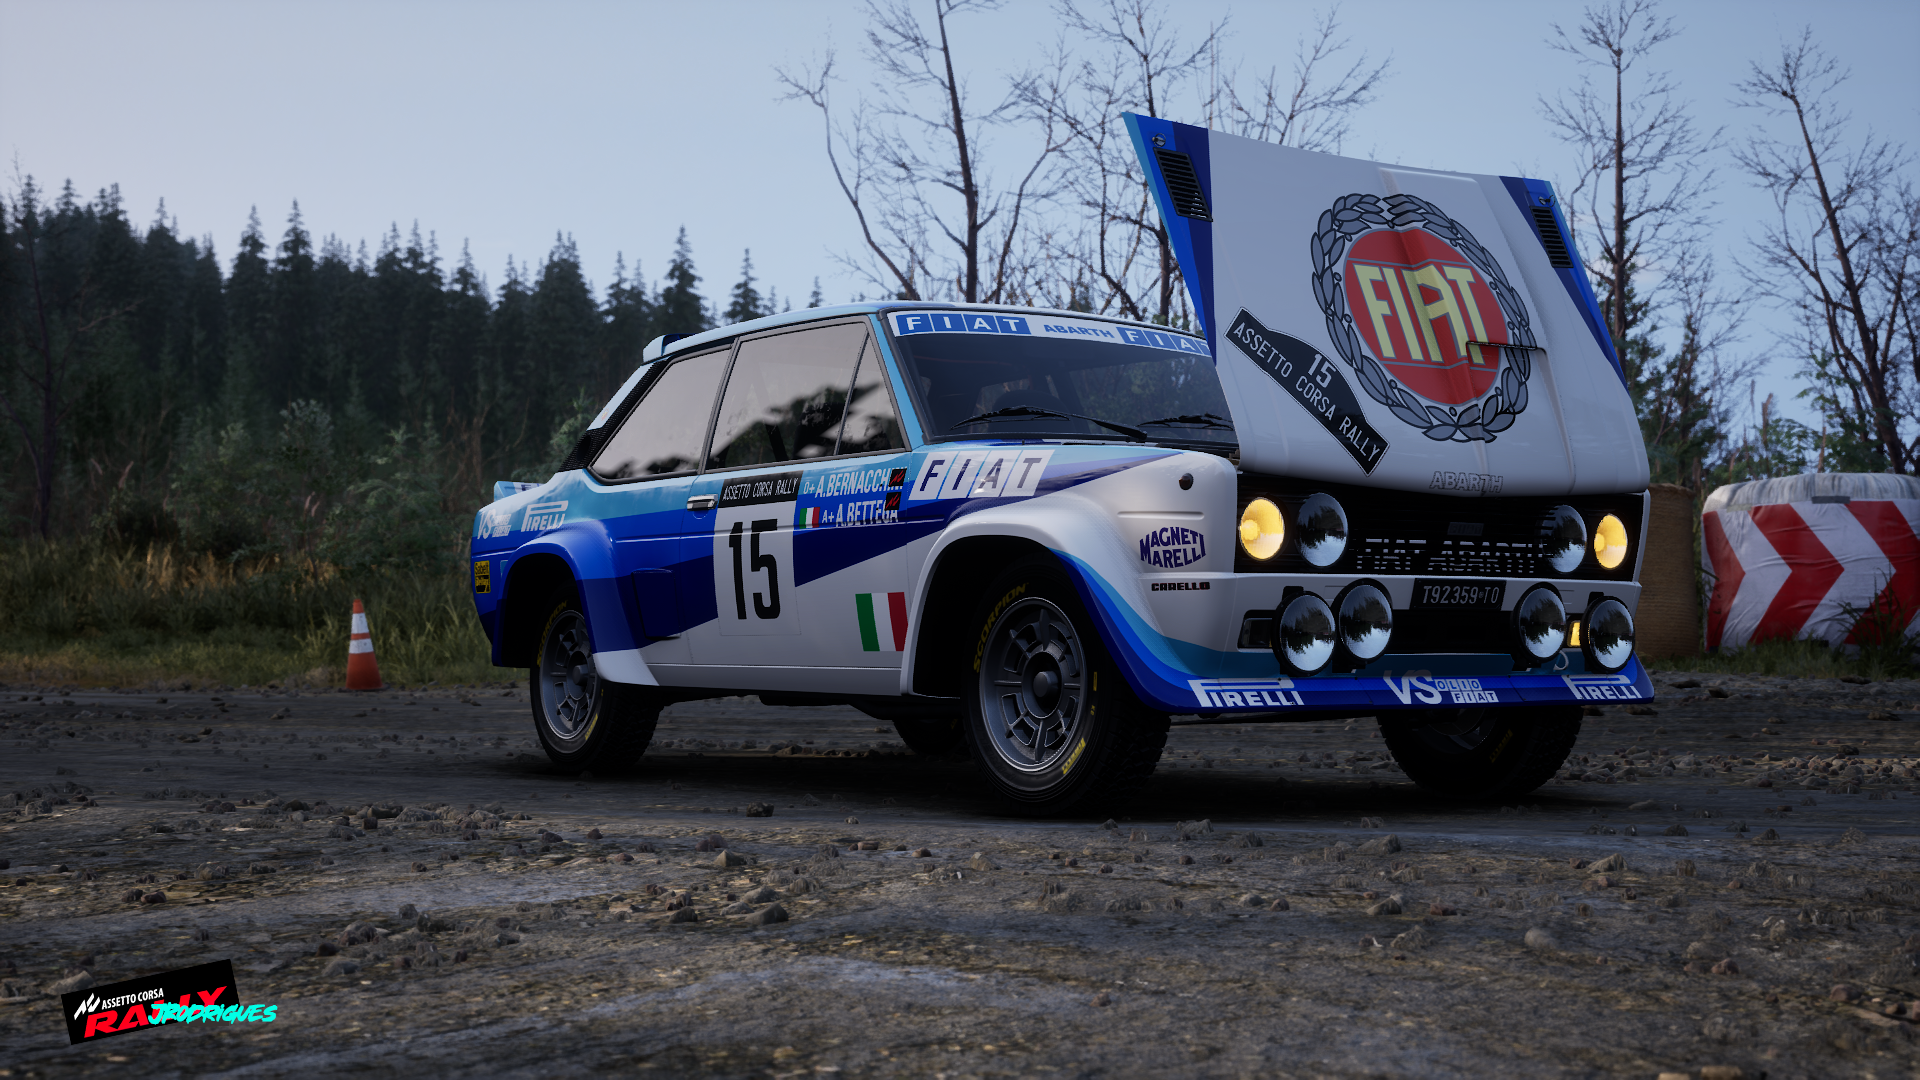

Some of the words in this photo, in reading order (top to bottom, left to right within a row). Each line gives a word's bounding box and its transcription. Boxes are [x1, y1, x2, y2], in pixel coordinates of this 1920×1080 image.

[905, 316, 1020, 332] FIAT
[1043, 324, 1115, 339] ABARTH
[1352, 264, 1486, 365] FIAT
[1307, 353, 1337, 388] 15
[1233, 322, 1293, 378] ASSETTO
[1295, 375, 1336, 421] CORSA
[1339, 416, 1381, 462] RALLY
[722, 483, 751, 502] ASSETTO
[752, 480, 773, 498] CORSA
[775, 477, 799, 496] RALLY
[814, 466, 907, 499] A.BERNACCH
[919, 457, 1043, 492] FIAT
[1428, 470, 1504, 494] ABARTH
[477, 509, 496, 540] VS
[521, 500, 569, 532] PIRELLI
[821, 509, 835, 524] A+
[1139, 526, 1206, 554] MAGNETI
[729, 518, 781, 620] 15
[1139, 544, 1206, 569] MARELLI
[1151, 581, 1211, 592] CARELLO
[973, 583, 1027, 674] SCORPION
[1187, 677, 1305, 708] PIRELLI
[1383, 669, 1442, 705] VS
[1437, 680, 1480, 690] OLIO
[1561, 674, 1643, 700] PIRELLI
[1454, 692, 1495, 702] FIAT
